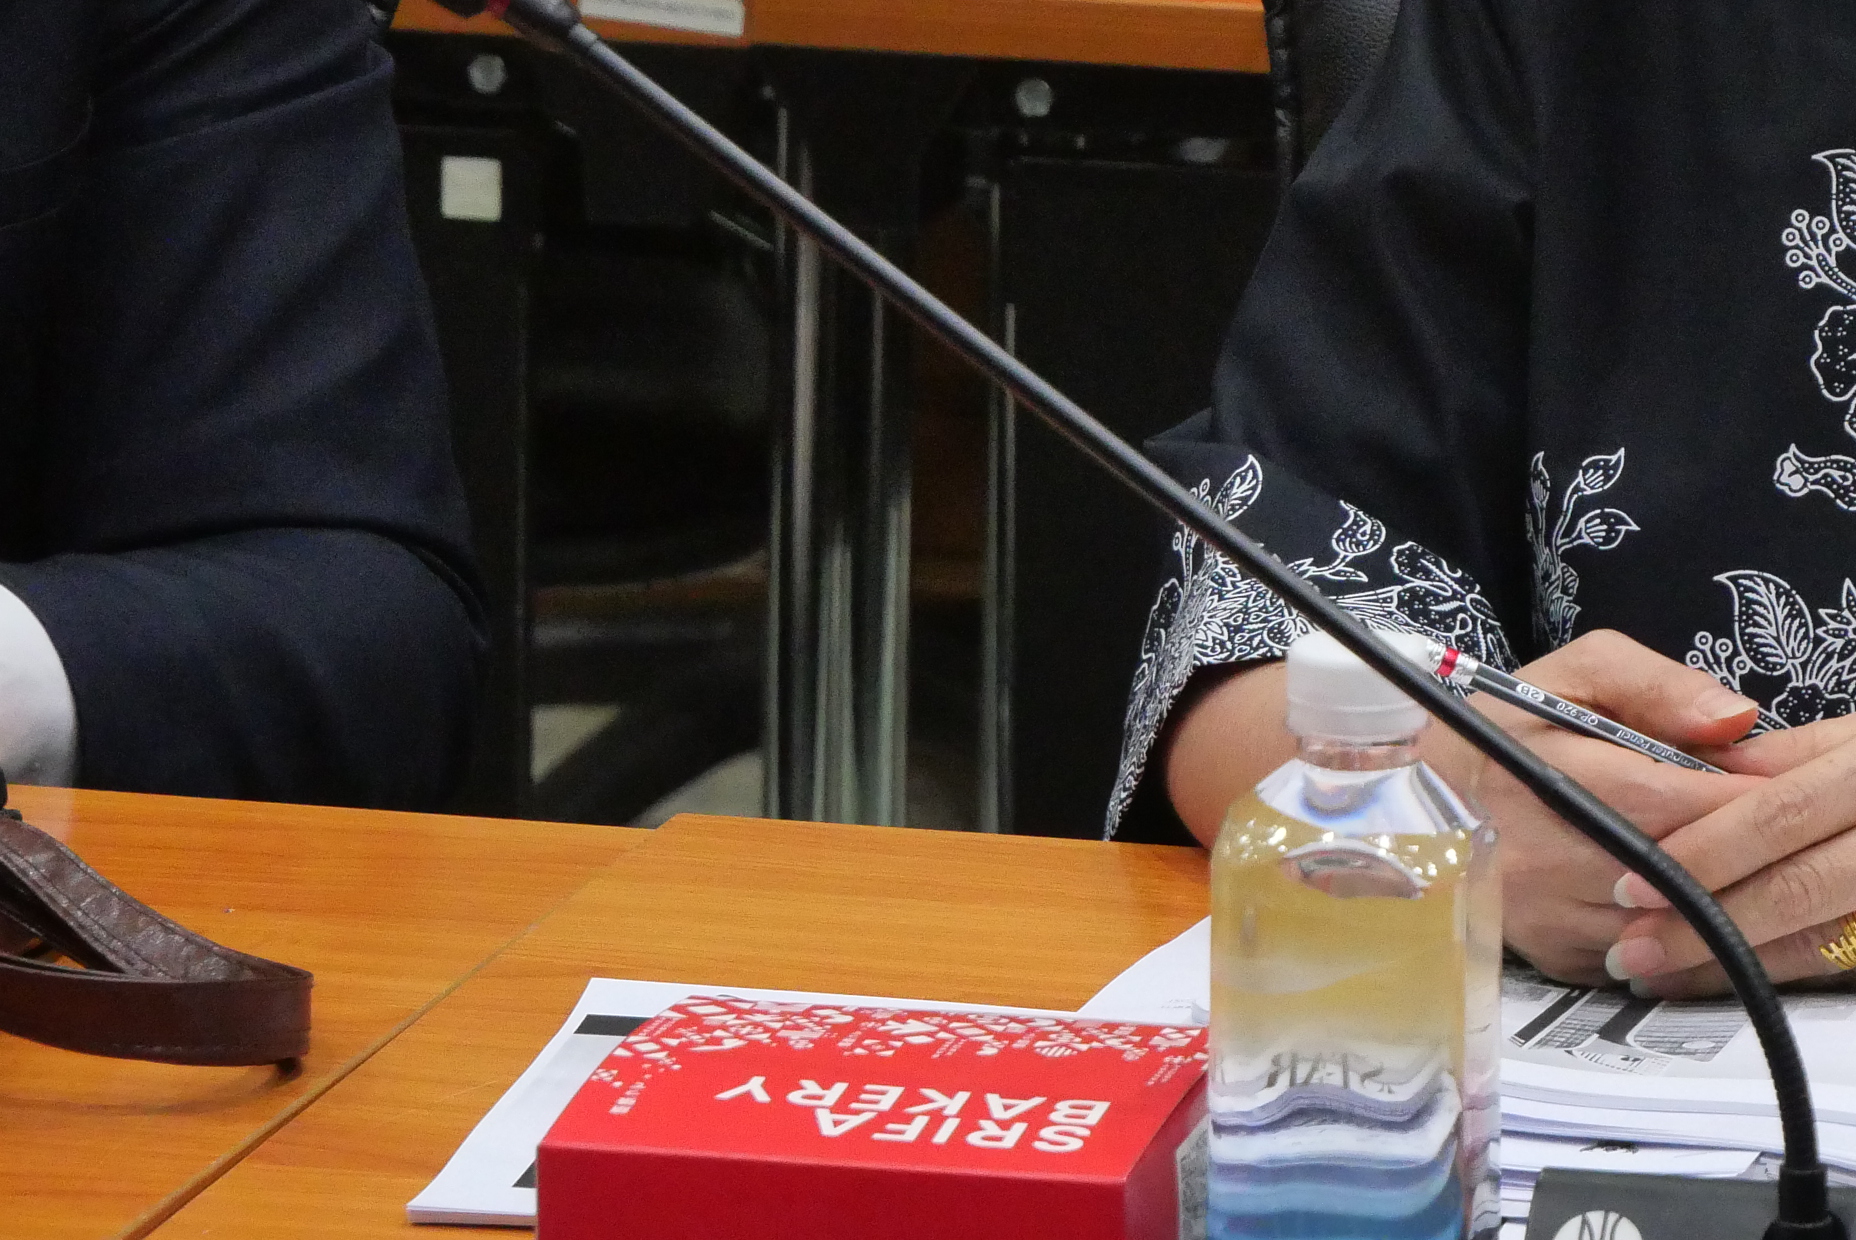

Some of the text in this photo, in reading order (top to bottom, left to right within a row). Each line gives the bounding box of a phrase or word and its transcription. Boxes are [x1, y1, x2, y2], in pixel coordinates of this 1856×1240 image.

[1518, 684, 1543, 701] 2B
[1616, 728, 1651, 751] Pencil
[714, 1075, 1111, 1127] BAKERY
[814, 1107, 1092, 1153] SRIFA
